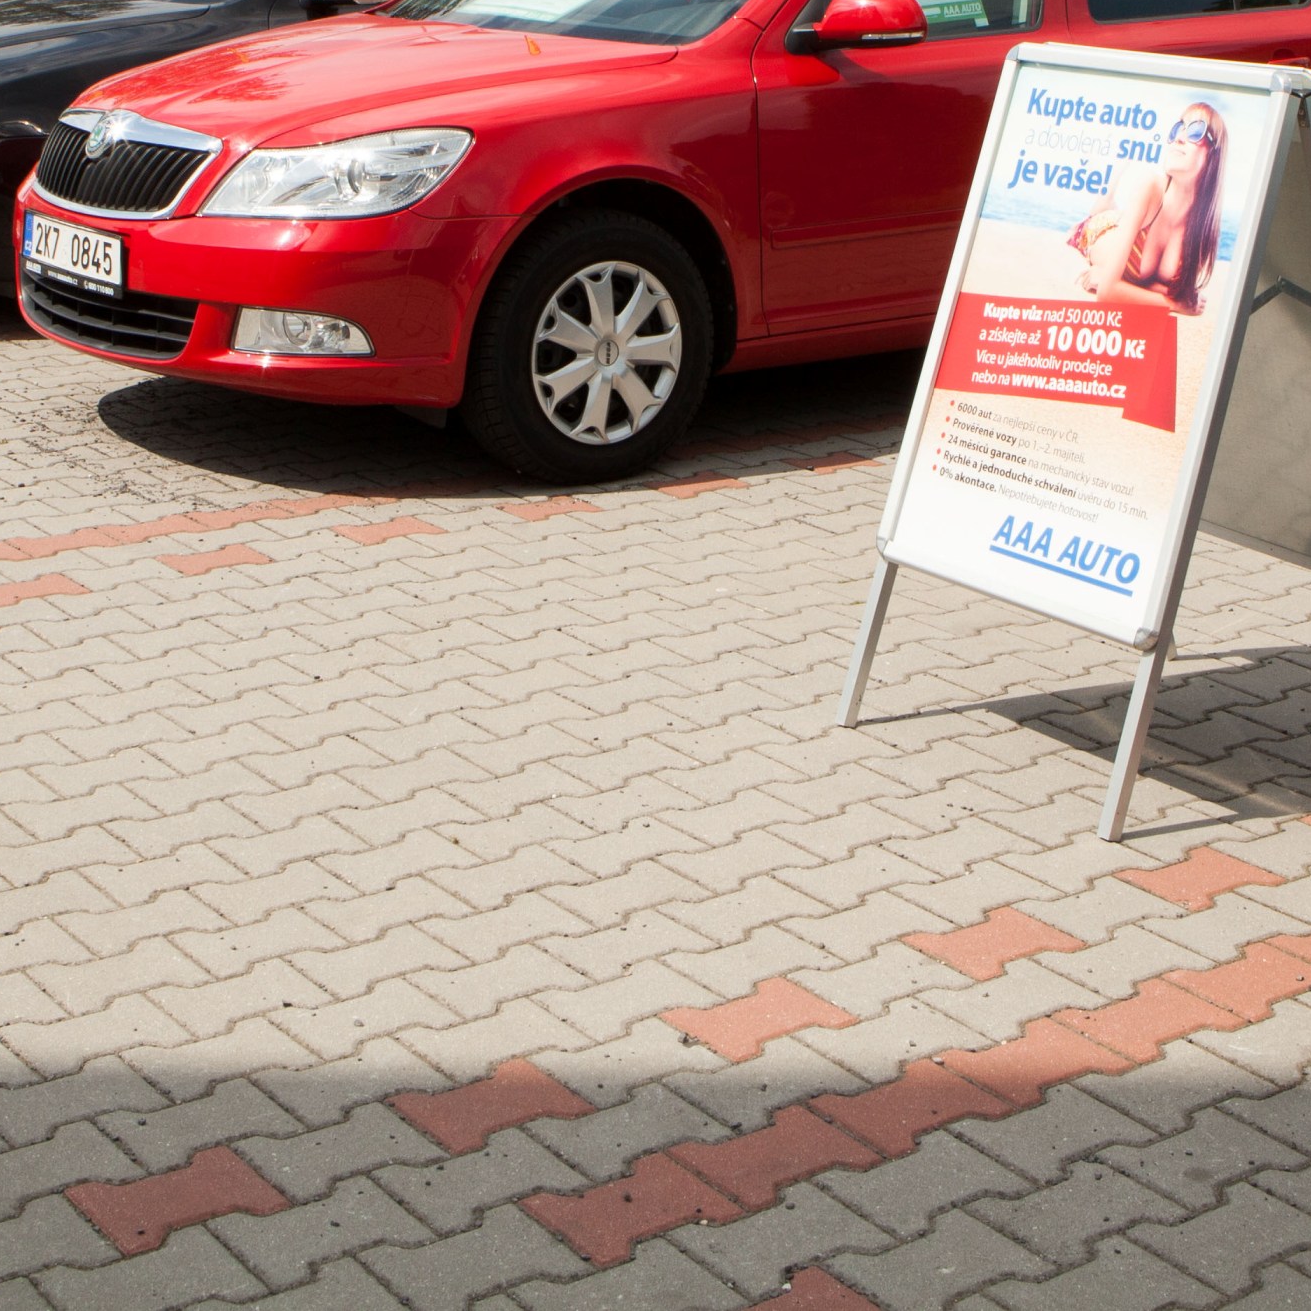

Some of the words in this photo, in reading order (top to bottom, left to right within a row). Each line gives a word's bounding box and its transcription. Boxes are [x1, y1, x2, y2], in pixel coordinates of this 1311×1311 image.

[944, 5, 960, 16] AAA
[961, 2, 982, 13] AUTO
[1027, 88, 1097, 126] Kupte
[1099, 103, 1157, 130] auto
[1038, 125, 1112, 157] dovolená
[1116, 133, 1162, 164] snů
[1007, 149, 1038, 189] je
[1044, 158, 1113, 196] vaše!
[35, 222, 60, 260] 2K7
[71, 233, 112, 276] 0845
[983, 302, 1021, 323] Kupte
[1022, 305, 1043, 322] vůz
[1043, 307, 1066, 323] nad
[1065, 308, 1081, 324] 50
[1082, 310, 1104, 326] 000
[1106, 311, 1123, 328] Kč
[979, 330, 987, 341] a
[988, 327, 1027, 347] získejte
[1028, 331, 1041, 346] až
[1047, 325, 1073, 352] 10
[1076, 328, 1122, 357] 000
[1124, 339, 1146, 359] Kč
[976, 349, 997, 364] Více
[997, 354, 1004, 365] u
[1003, 352, 1061, 372] jakéhokoliv
[1061, 358, 1113, 378] prodejce
[971, 370, 997, 385] nebo
[998, 374, 1010, 386] na
[1011, 372, 1127, 399] www.aaaauto.cz
[953, 417, 995, 438] Prověřené
[996, 431, 1018, 447] vozy
[1018, 437, 1031, 450] po
[957, 402, 978, 416] 6000
[978, 409, 992, 420] aut
[992, 413, 1002, 423] za
[1003, 415, 1035, 433] nejlepší
[1036, 425, 1058, 440] ceny
[948, 434, 958, 445] 24
[959, 437, 989, 455] měsíců
[990, 448, 1027, 466] garance
[1028, 458, 1039, 469] na
[1092, 476, 1110, 490] stav
[1111, 482, 1135, 497] vozu!
[939, 466, 953, 480] 0%
[954, 471, 997, 493] akontace.
[1058, 502, 1100, 523] hotovost!
[943, 450, 971, 467] Rychlé
[972, 461, 978, 469] a
[978, 460, 1033, 485] jednoduché
[1034, 478, 1077, 498] schválení
[1103, 496, 1116, 511] do
[1118, 500, 1128, 514] 15
[1129, 506, 1149, 521] min.
[992, 515, 1053, 559] AAA
[1056, 535, 1140, 584] AUTO
